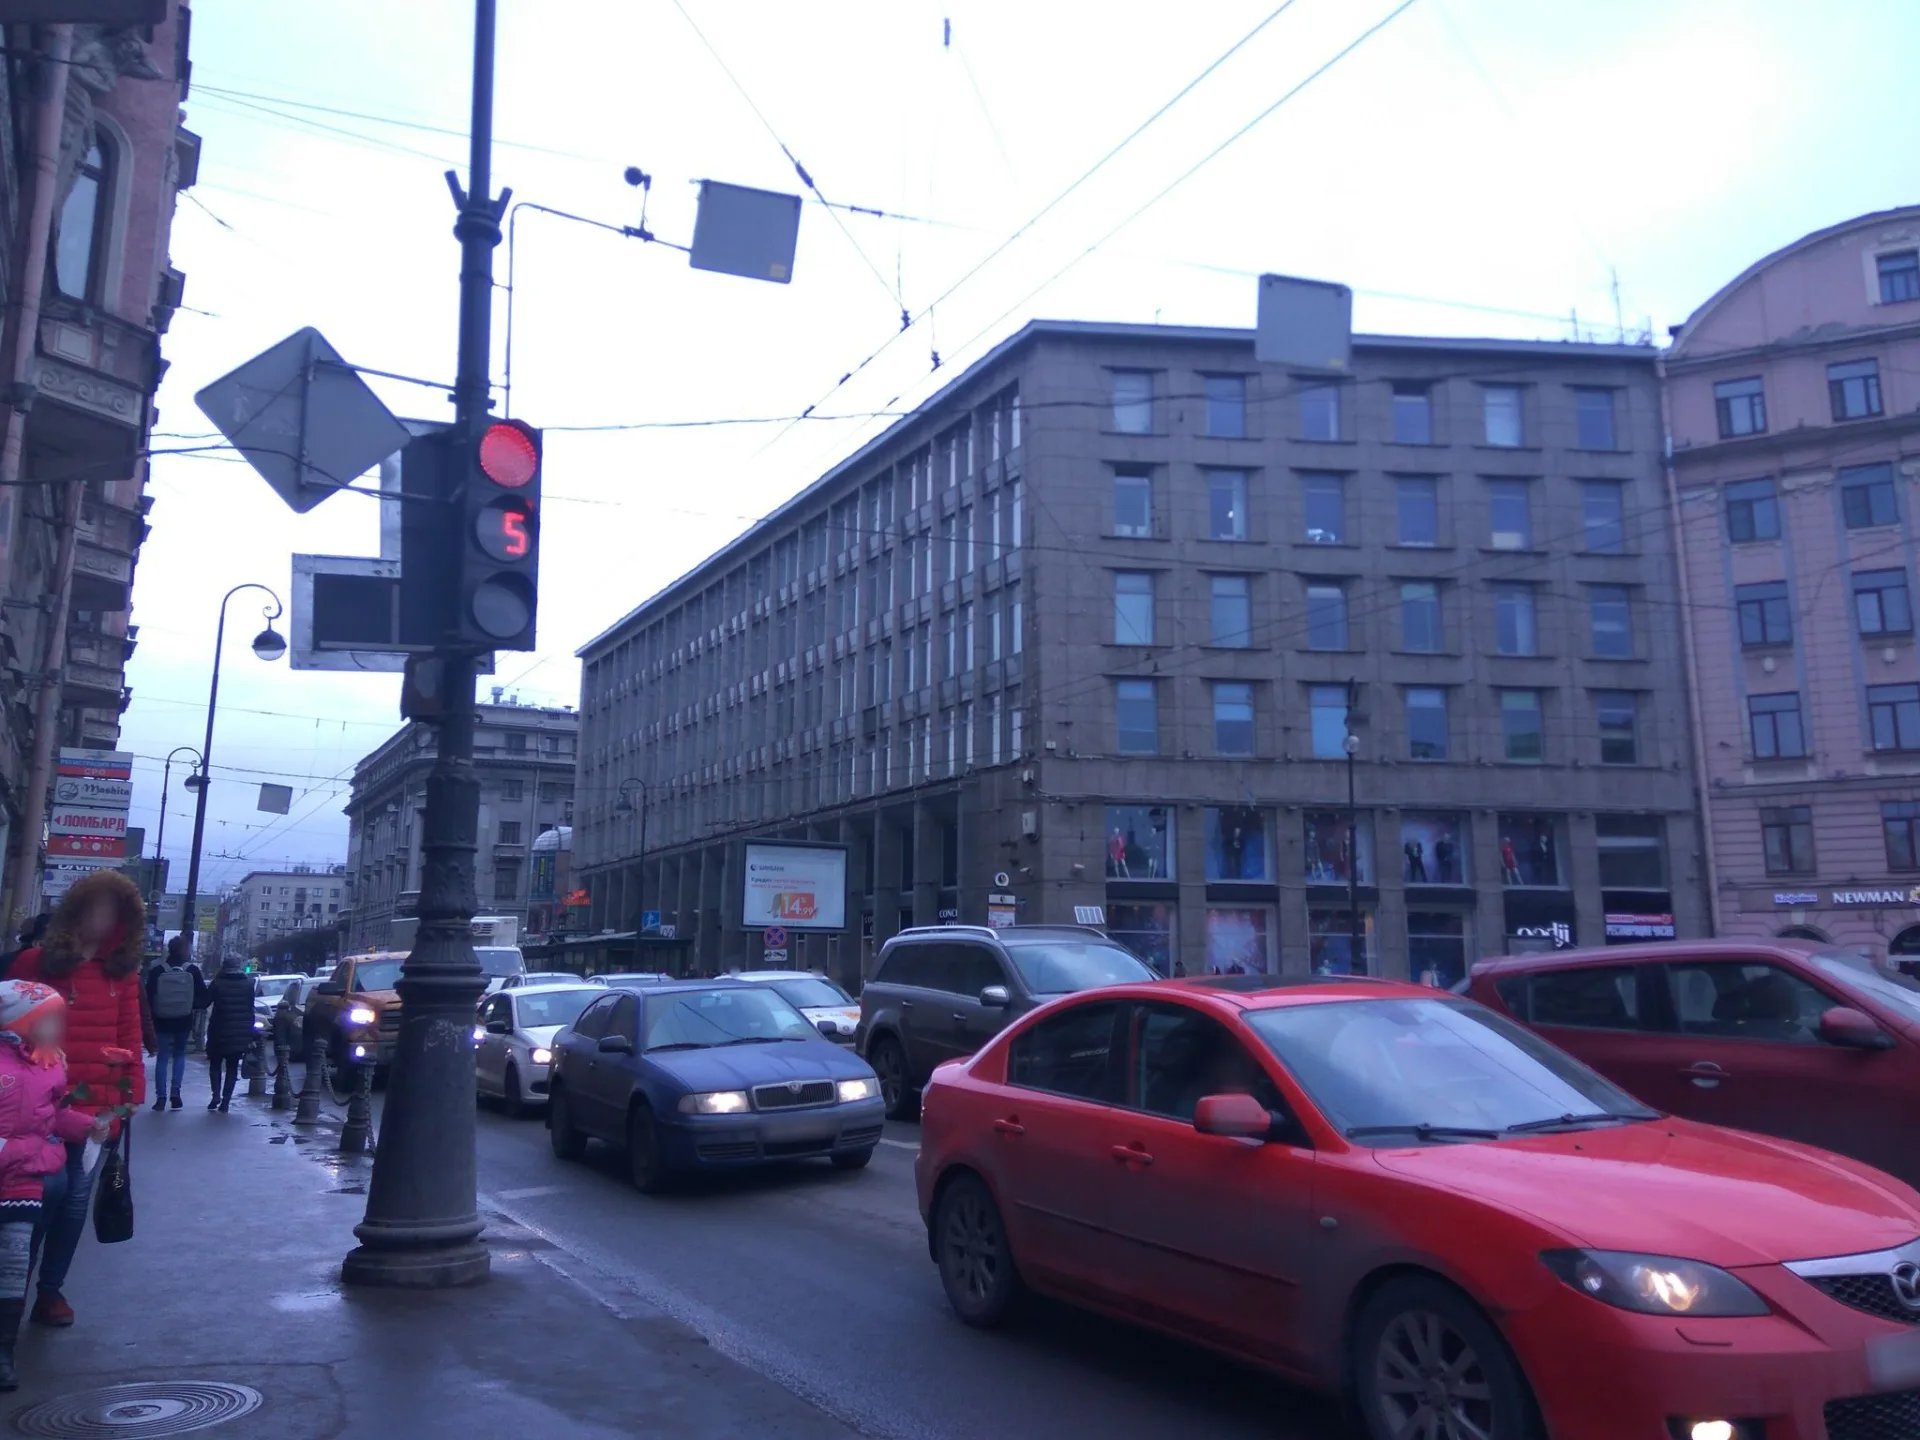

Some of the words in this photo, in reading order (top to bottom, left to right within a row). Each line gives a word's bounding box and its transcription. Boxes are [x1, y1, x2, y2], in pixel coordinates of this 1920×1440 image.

[503, 511, 527, 555] 5
[63, 814, 126, 832] ЛОМБАРД
[1832, 890, 1904, 904] NEWMAN
